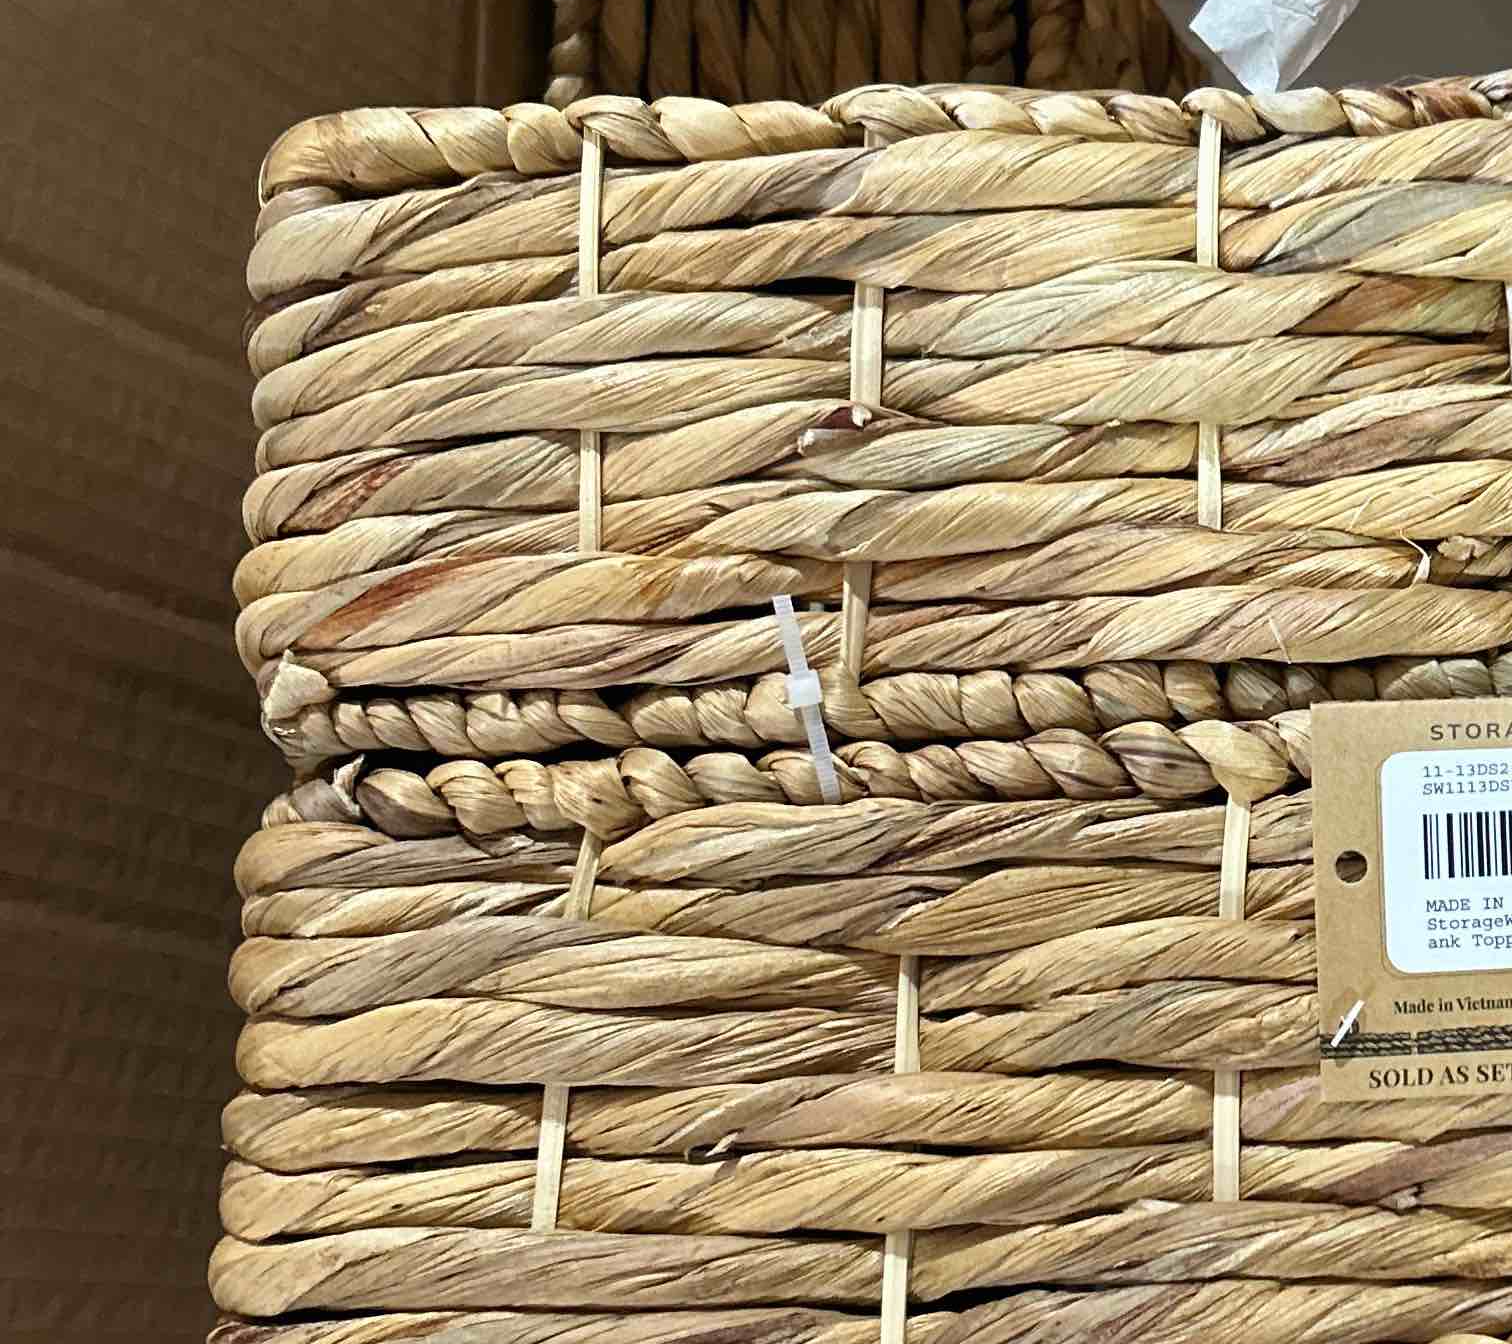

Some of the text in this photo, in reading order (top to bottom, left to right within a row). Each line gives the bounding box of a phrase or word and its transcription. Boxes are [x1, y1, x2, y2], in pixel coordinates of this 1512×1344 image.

[1425, 898, 1472, 913] MADE
[1483, 896, 1504, 910] IN
[1427, 934, 1462, 949] ank
[1393, 998, 1435, 1015] Made
[1438, 997, 1454, 1013] in
[1368, 1066, 1434, 1089] SOLD
[1439, 1065, 1470, 1085] AS
